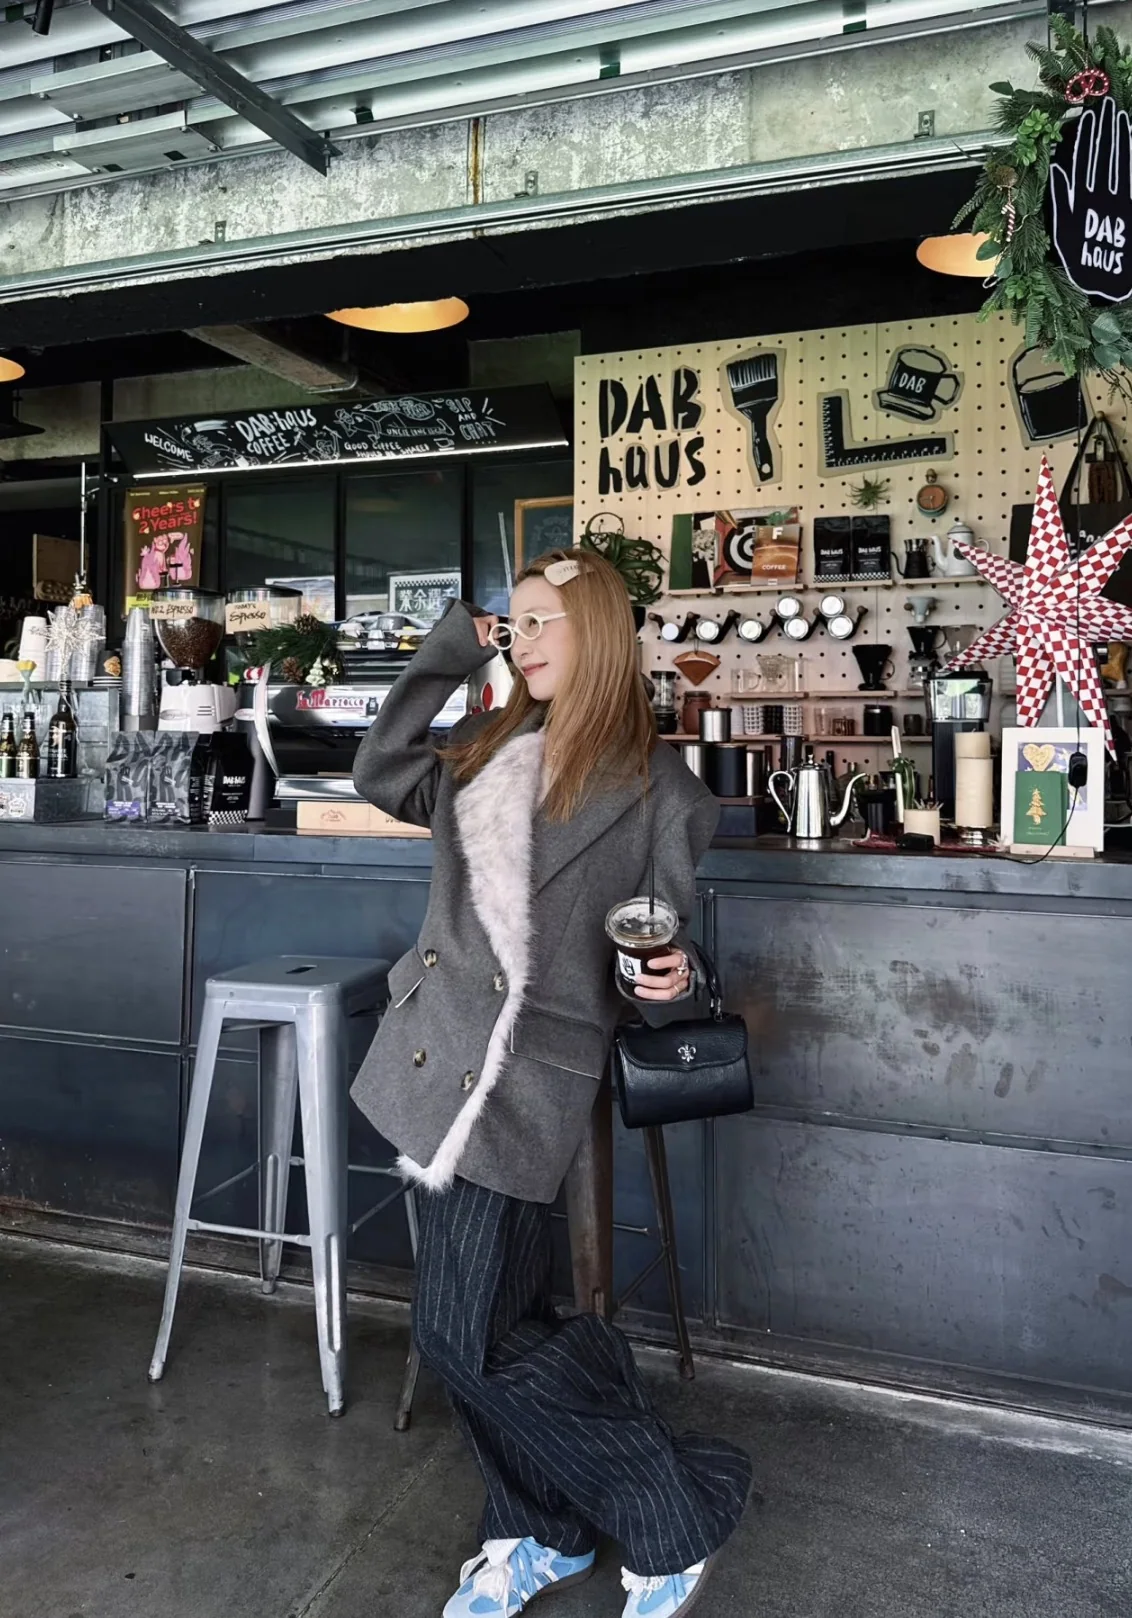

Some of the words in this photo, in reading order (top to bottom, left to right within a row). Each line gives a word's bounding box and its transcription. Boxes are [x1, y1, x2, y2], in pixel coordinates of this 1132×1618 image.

[1084, 208, 1126, 248] DAB
[898, 373, 927, 393] DAB
[600, 367, 703, 438] DAB
[458, 412, 477, 422] AND
[459, 421, 496, 441] CHAT
[144, 432, 195, 463] WELCOME
[246, 432, 291, 456] COFFEE
[344, 441, 369, 451] GOOD
[133, 501, 184, 520] Cheers
[139, 520, 149, 534] 2
[150, 511, 197, 532] Years!
[772, 527, 783, 540] F
